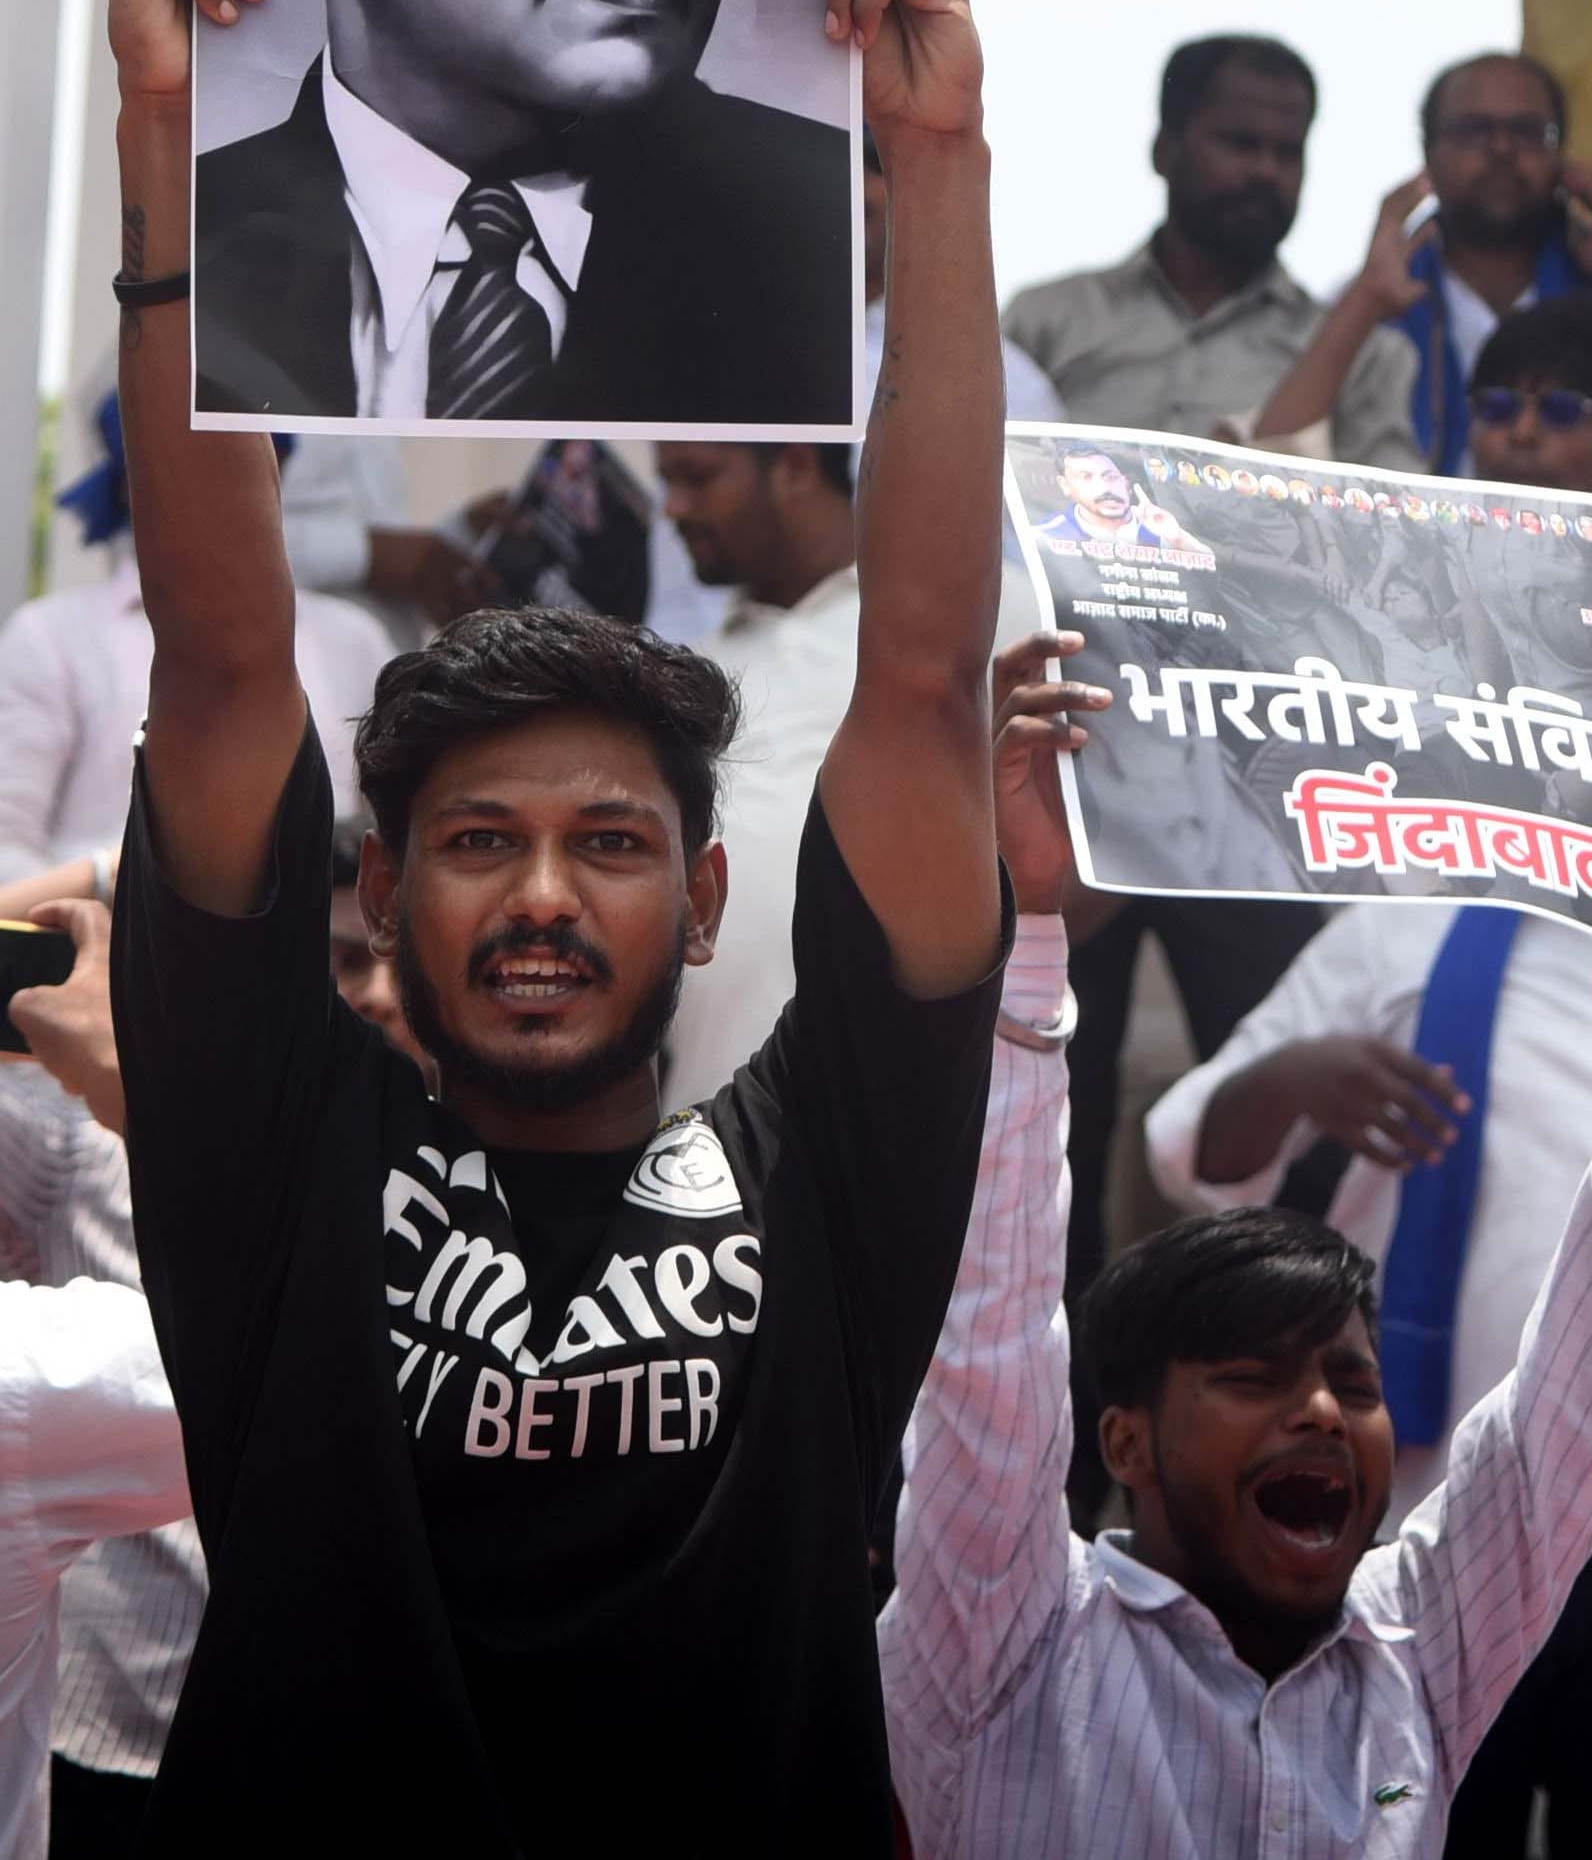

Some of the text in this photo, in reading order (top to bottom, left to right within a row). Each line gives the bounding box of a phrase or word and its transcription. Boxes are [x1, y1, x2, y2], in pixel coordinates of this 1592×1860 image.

[1117, 604, 1157, 621] समाज
[1119, 656, 1421, 750] भारतीय
[464, 1358, 721, 1460] BETTER
